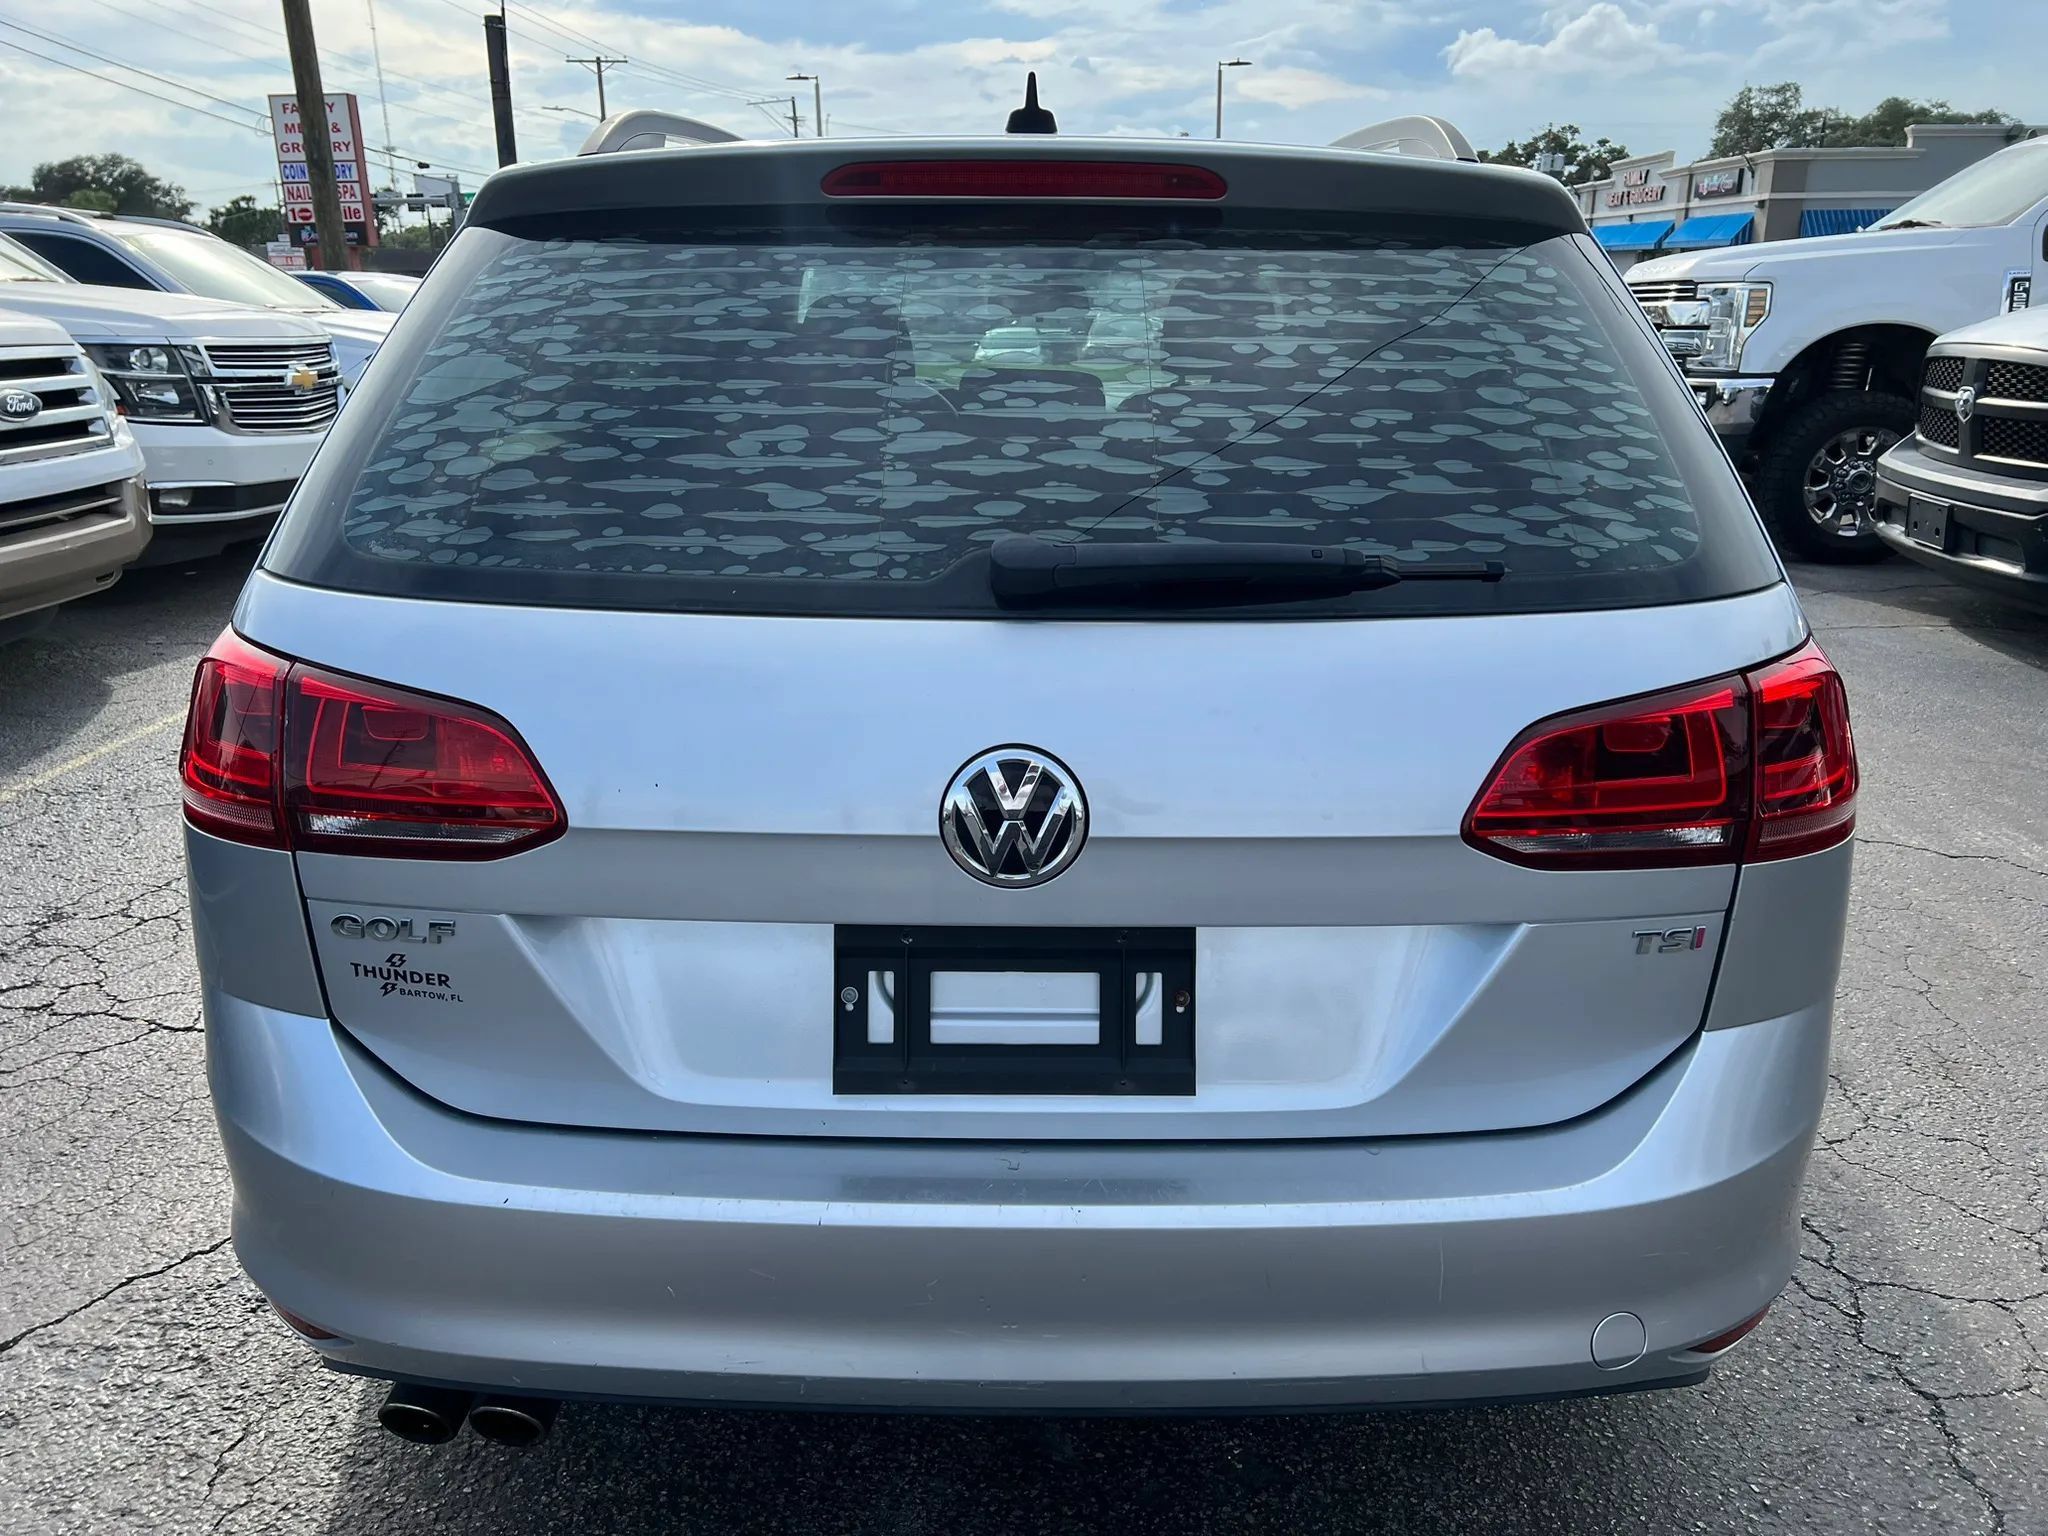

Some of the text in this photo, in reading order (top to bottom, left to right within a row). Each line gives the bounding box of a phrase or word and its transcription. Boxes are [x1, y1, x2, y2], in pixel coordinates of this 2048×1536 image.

[282, 102, 335, 114] FAY
[331, 122, 341, 133] &
[280, 141, 351, 153] GRRY
[283, 164, 307, 179] COIN
[6, 394, 36, 413] Ford
[330, 912, 456, 944] GOLF
[1631, 925, 1707, 955] TSI
[350, 962, 452, 989] THUNDER
[400, 988, 464, 1003] BARTOW, FL
